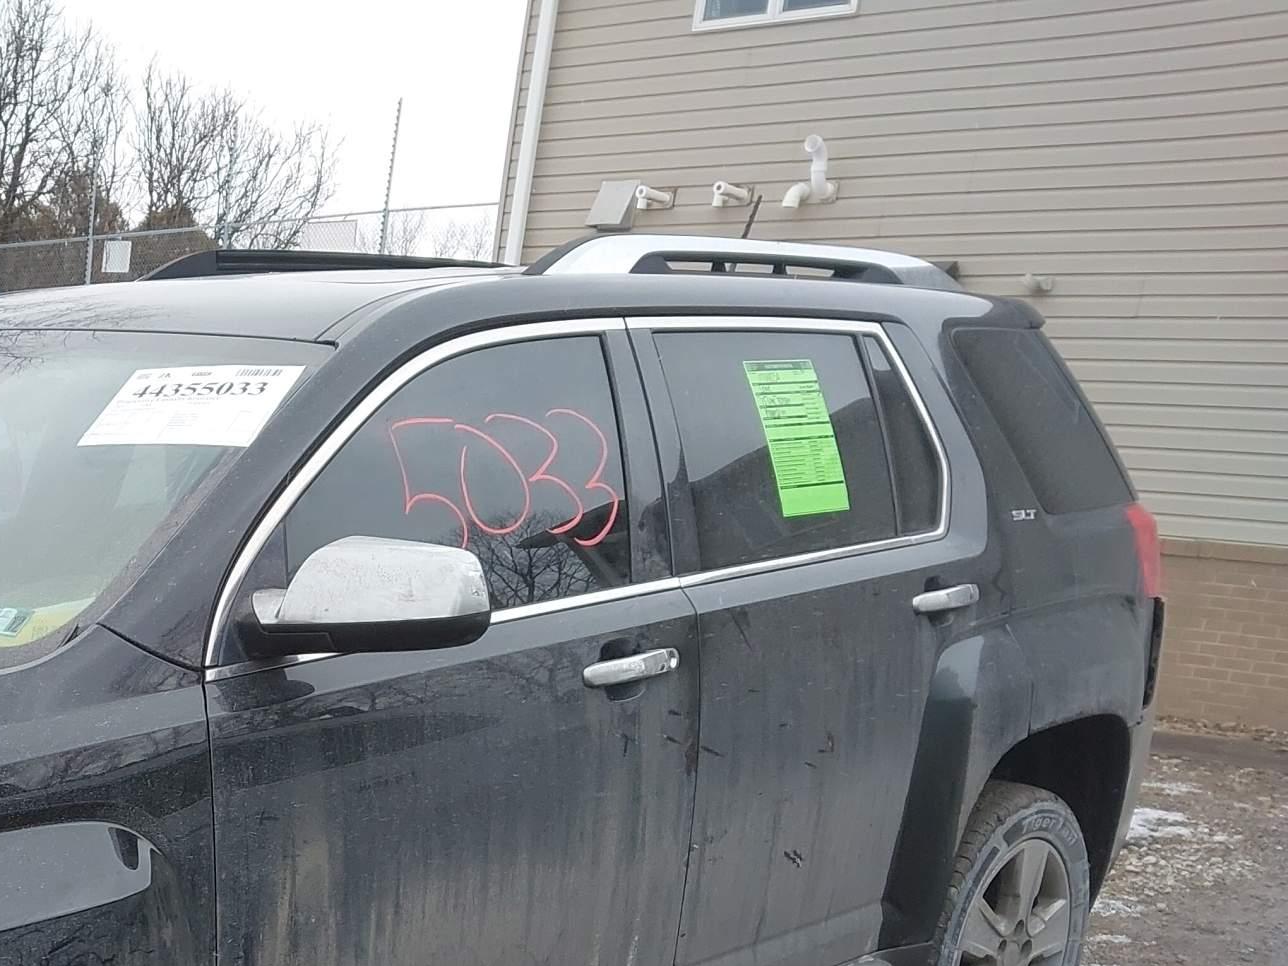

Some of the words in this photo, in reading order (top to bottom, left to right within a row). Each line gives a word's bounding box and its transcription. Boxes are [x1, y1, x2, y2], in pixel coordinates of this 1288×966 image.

[132, 381, 269, 398] 44355033
[389, 408, 619, 549] 5033
[1011, 508, 1037, 521] SLT
